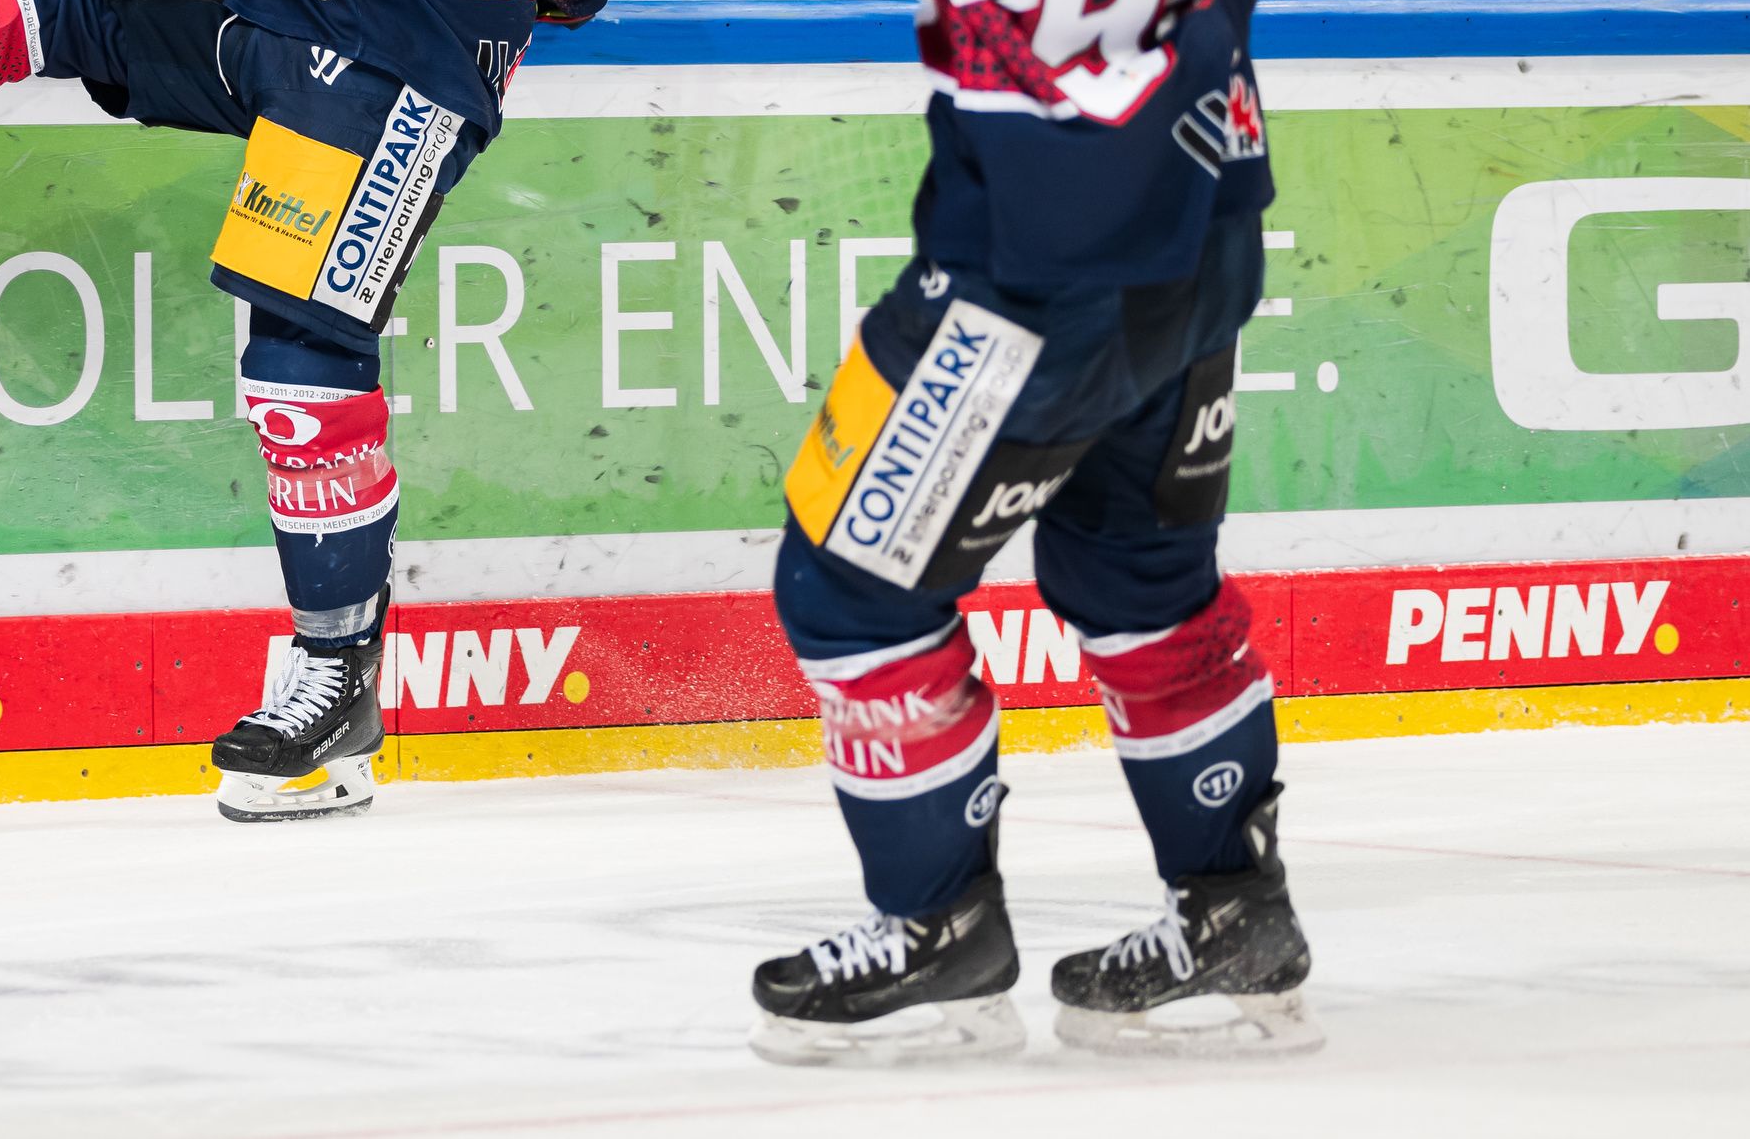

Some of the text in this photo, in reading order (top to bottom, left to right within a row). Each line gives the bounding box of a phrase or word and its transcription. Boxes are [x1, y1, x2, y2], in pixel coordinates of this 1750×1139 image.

[243, 181, 333, 237] Knittel
[326, 91, 434, 294] CONTIPARK
[270, 386, 288, 397] 2011
[293, 388, 315, 399] 2012
[845, 315, 989, 548] CONTIPARK
[322, 514, 366, 531] MEISTER
